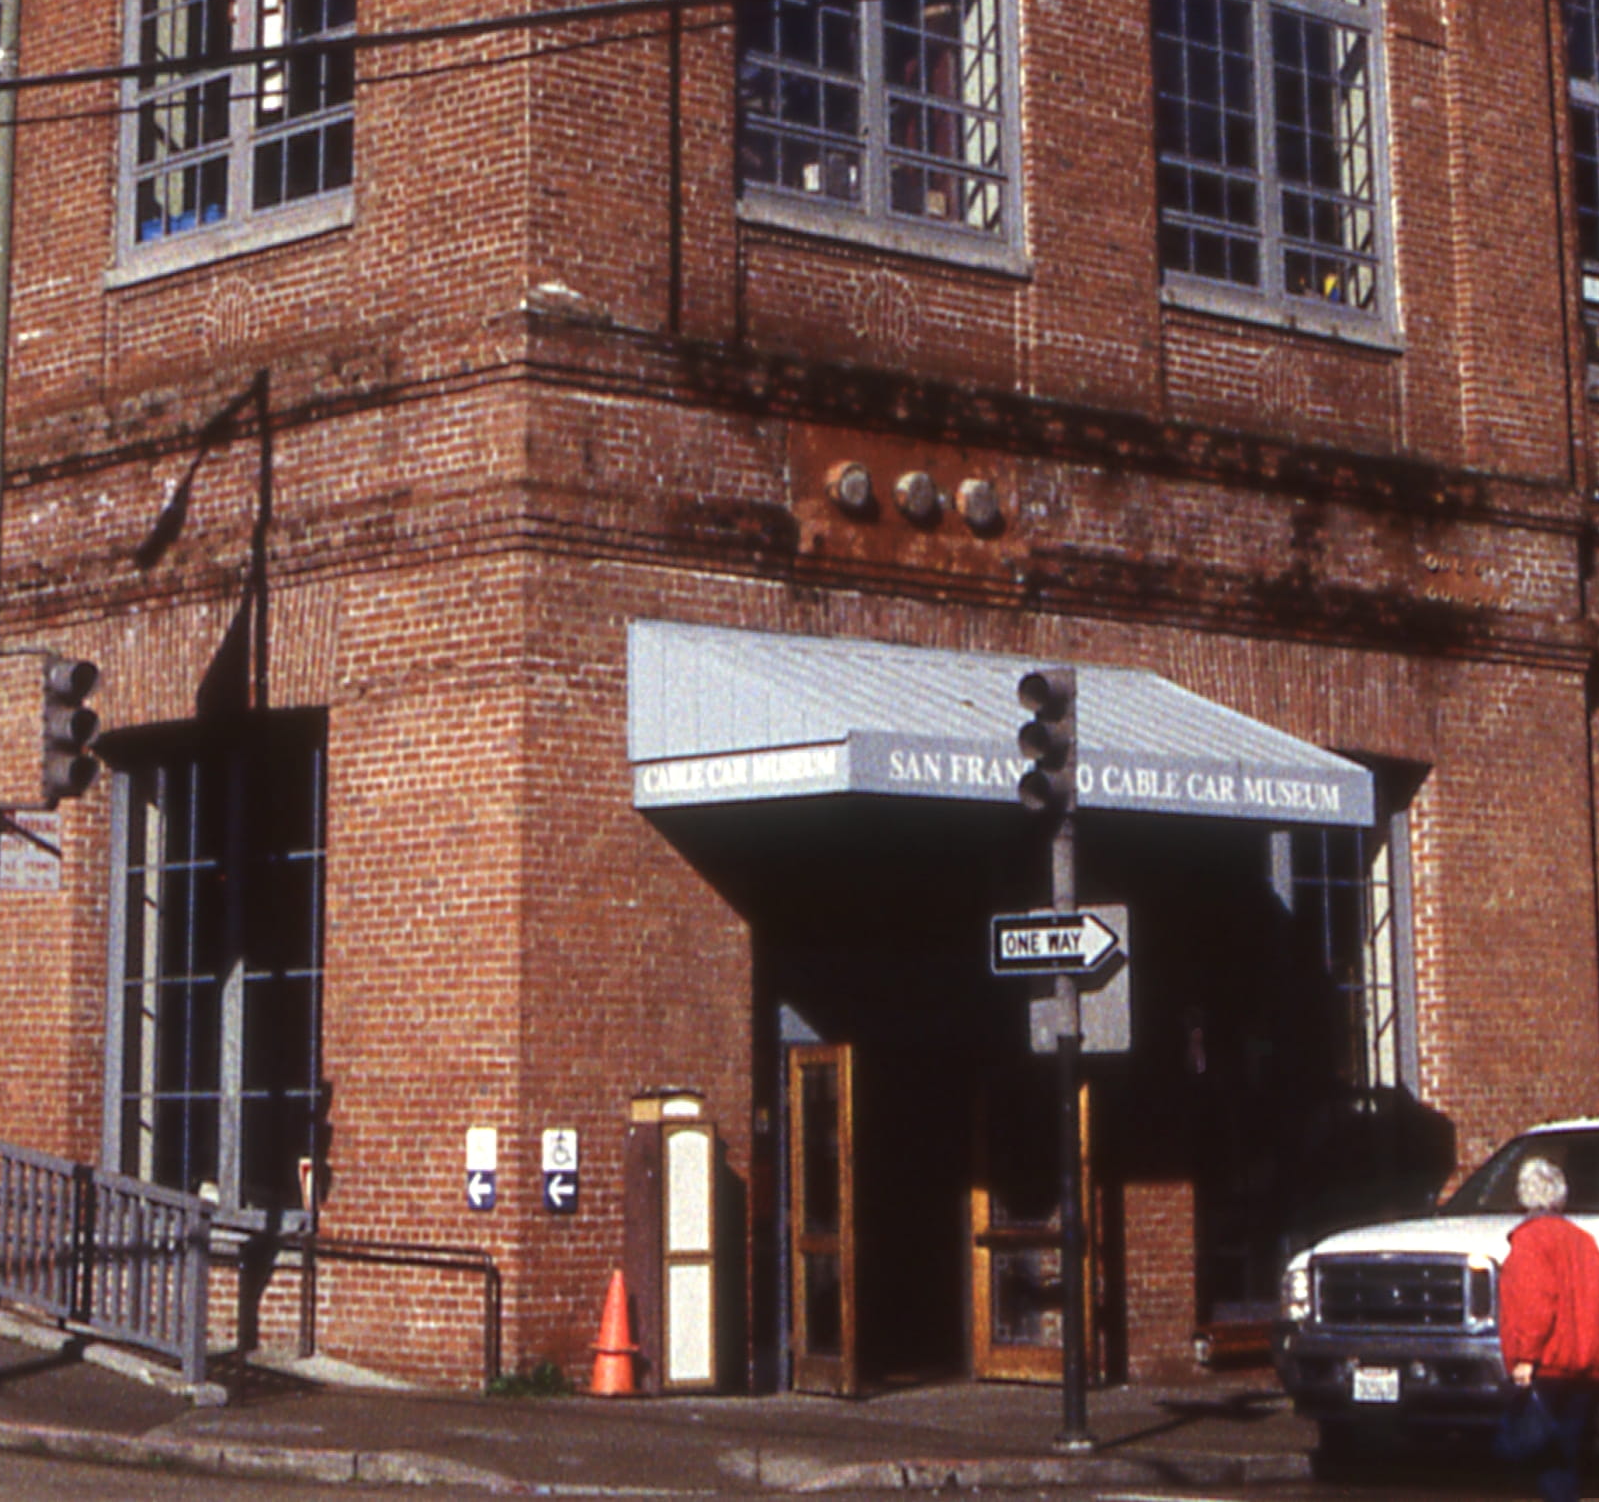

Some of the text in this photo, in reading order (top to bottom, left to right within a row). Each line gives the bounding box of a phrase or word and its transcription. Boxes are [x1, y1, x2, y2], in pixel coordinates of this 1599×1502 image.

[643, 750, 838, 794] CABLE CAR MUSEUM
[888, 749, 943, 783] SAN
[1101, 767, 1183, 800] CABLE
[1186, 774, 1237, 804] CAR
[1241, 776, 1341, 812] MUSEUM
[1005, 930, 1081, 955] ONE WAY
